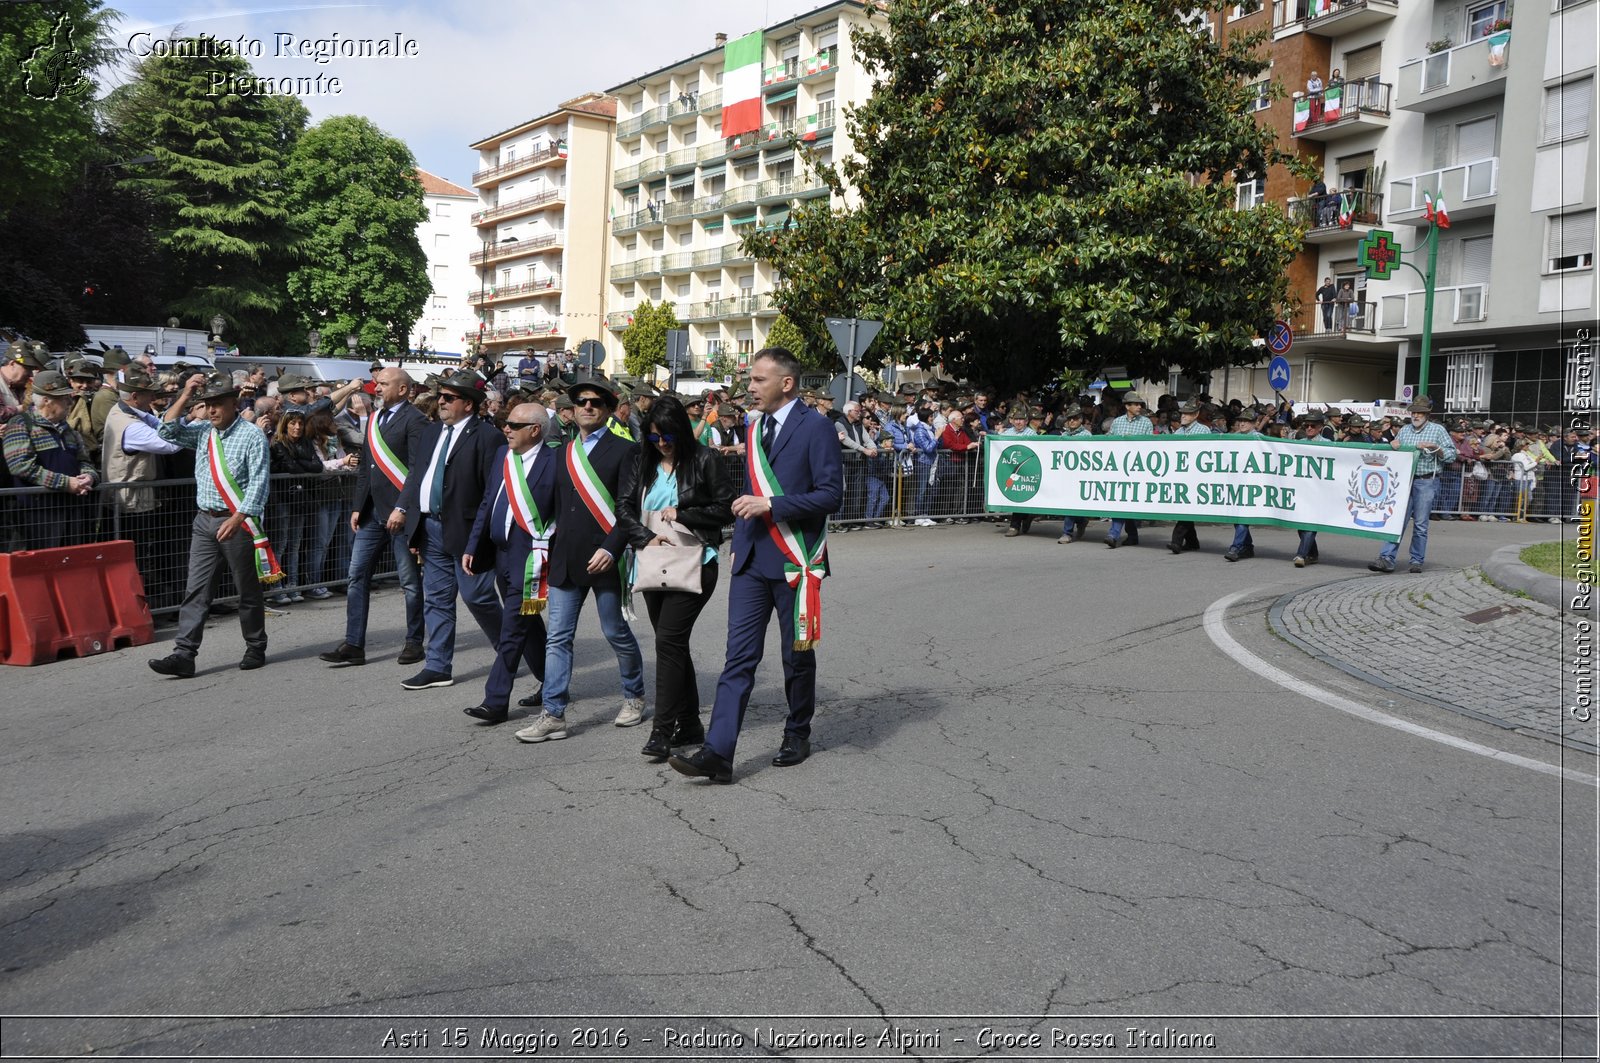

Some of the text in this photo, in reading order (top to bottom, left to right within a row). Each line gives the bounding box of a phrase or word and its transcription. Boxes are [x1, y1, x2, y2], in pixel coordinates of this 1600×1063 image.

[1051, 450, 1336, 481] FOSSA (AQ) E GLI ALPINI
[1011, 484, 1036, 492] ALPINI
[1079, 480, 1297, 511] UNITI PER SEMPRE
